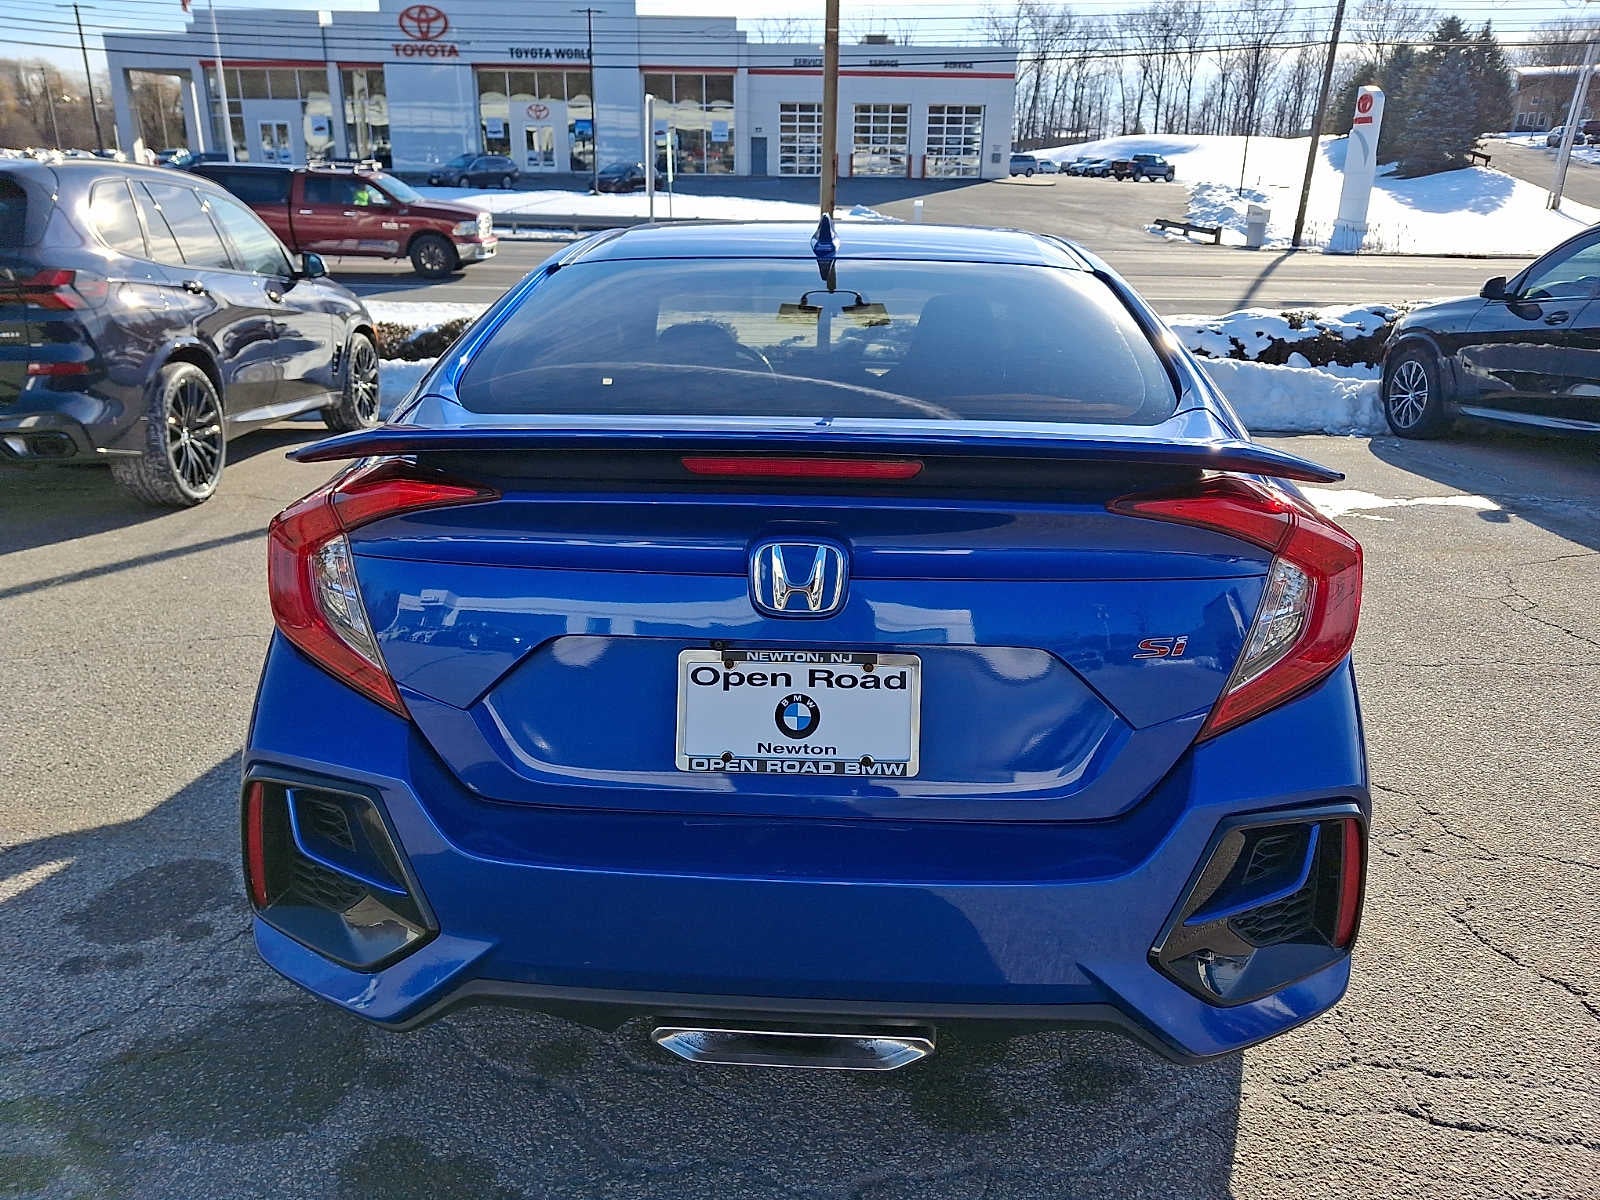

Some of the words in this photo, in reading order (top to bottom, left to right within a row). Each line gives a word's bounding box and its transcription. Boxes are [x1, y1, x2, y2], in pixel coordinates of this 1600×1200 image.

[391, 43, 459, 57] TOYOTA
[509, 47, 552, 59] TOYOTA
[1132, 635, 1189, 659] Si
[746, 651, 824, 662] NEWTON,
[830, 652, 853, 663] NJ
[690, 666, 792, 691] Open
[808, 669, 907, 690] Road
[781, 694, 816, 709] BMW
[757, 742, 837, 756] Newton
[691, 758, 758, 772] OPEN
[766, 760, 835, 774] ROAD
[844, 761, 904, 776] BMW
